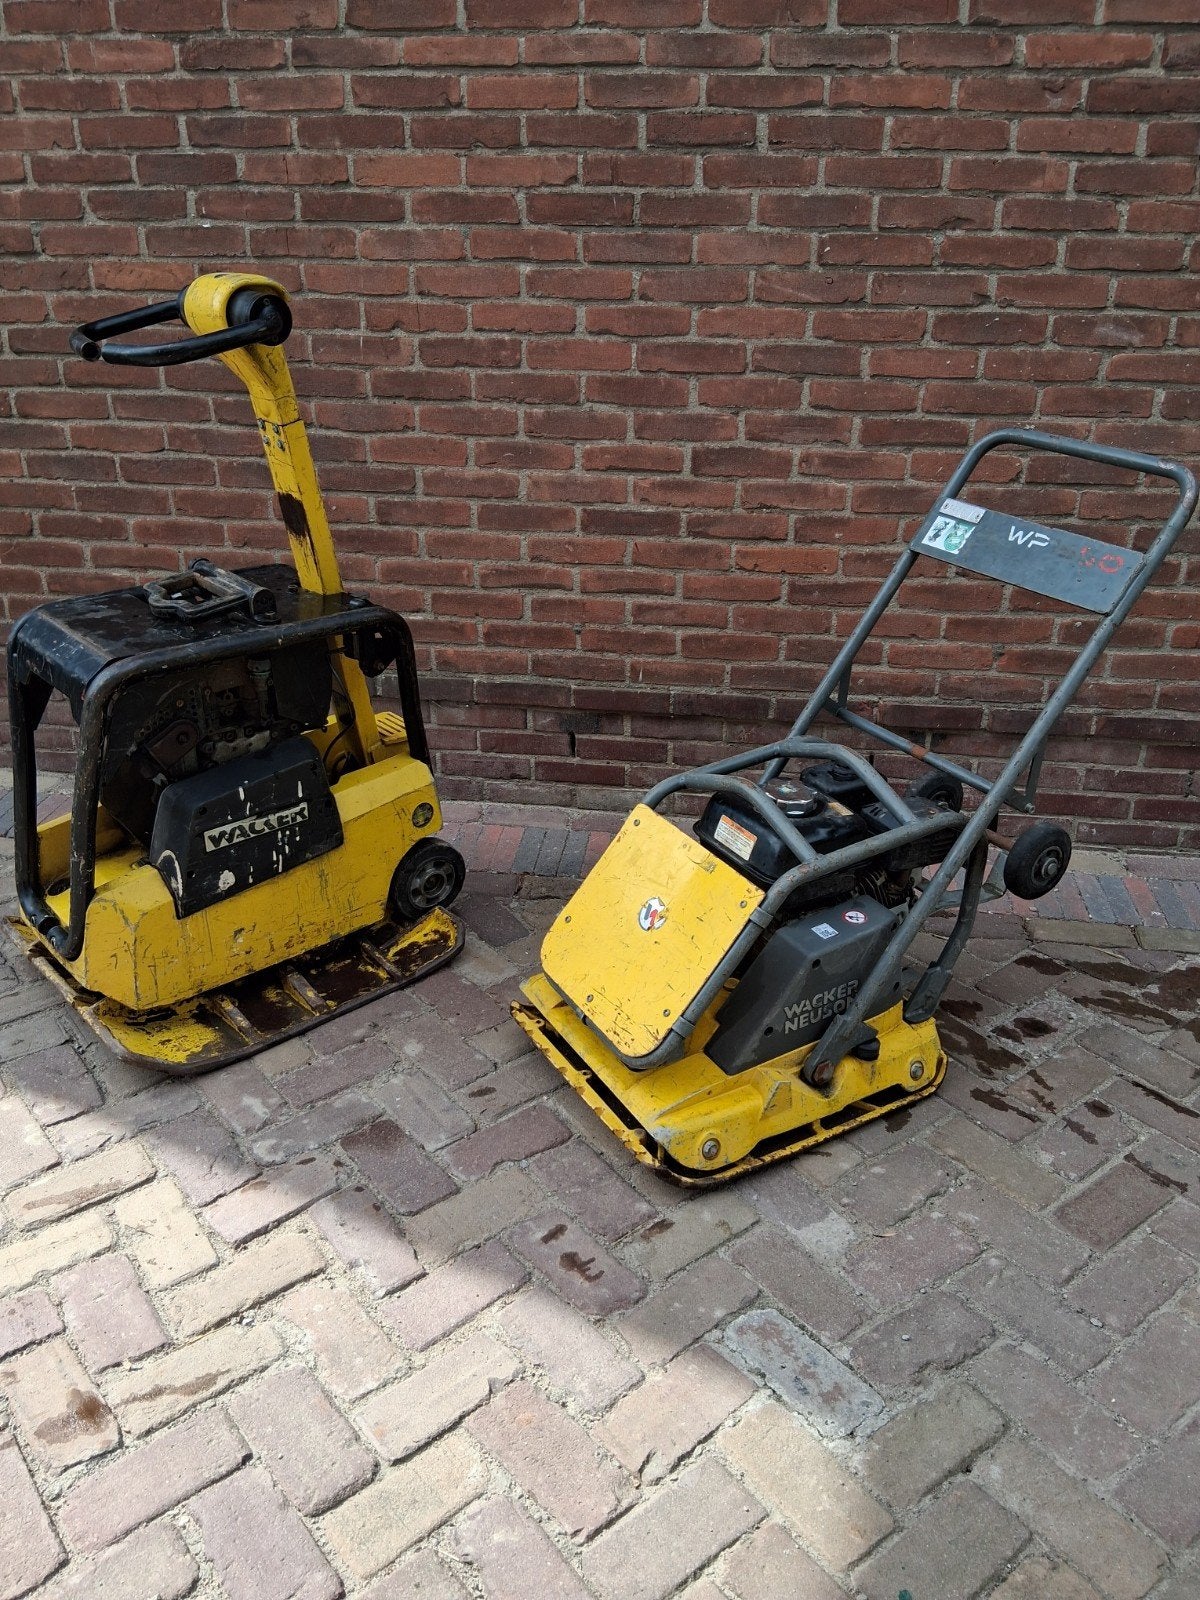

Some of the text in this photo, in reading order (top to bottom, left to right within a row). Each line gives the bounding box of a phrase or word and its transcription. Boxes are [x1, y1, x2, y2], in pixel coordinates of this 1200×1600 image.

[1008, 525, 1050, 549] WP
[208, 806, 308, 849] WACKER
[784, 979, 859, 1019] WACKER
